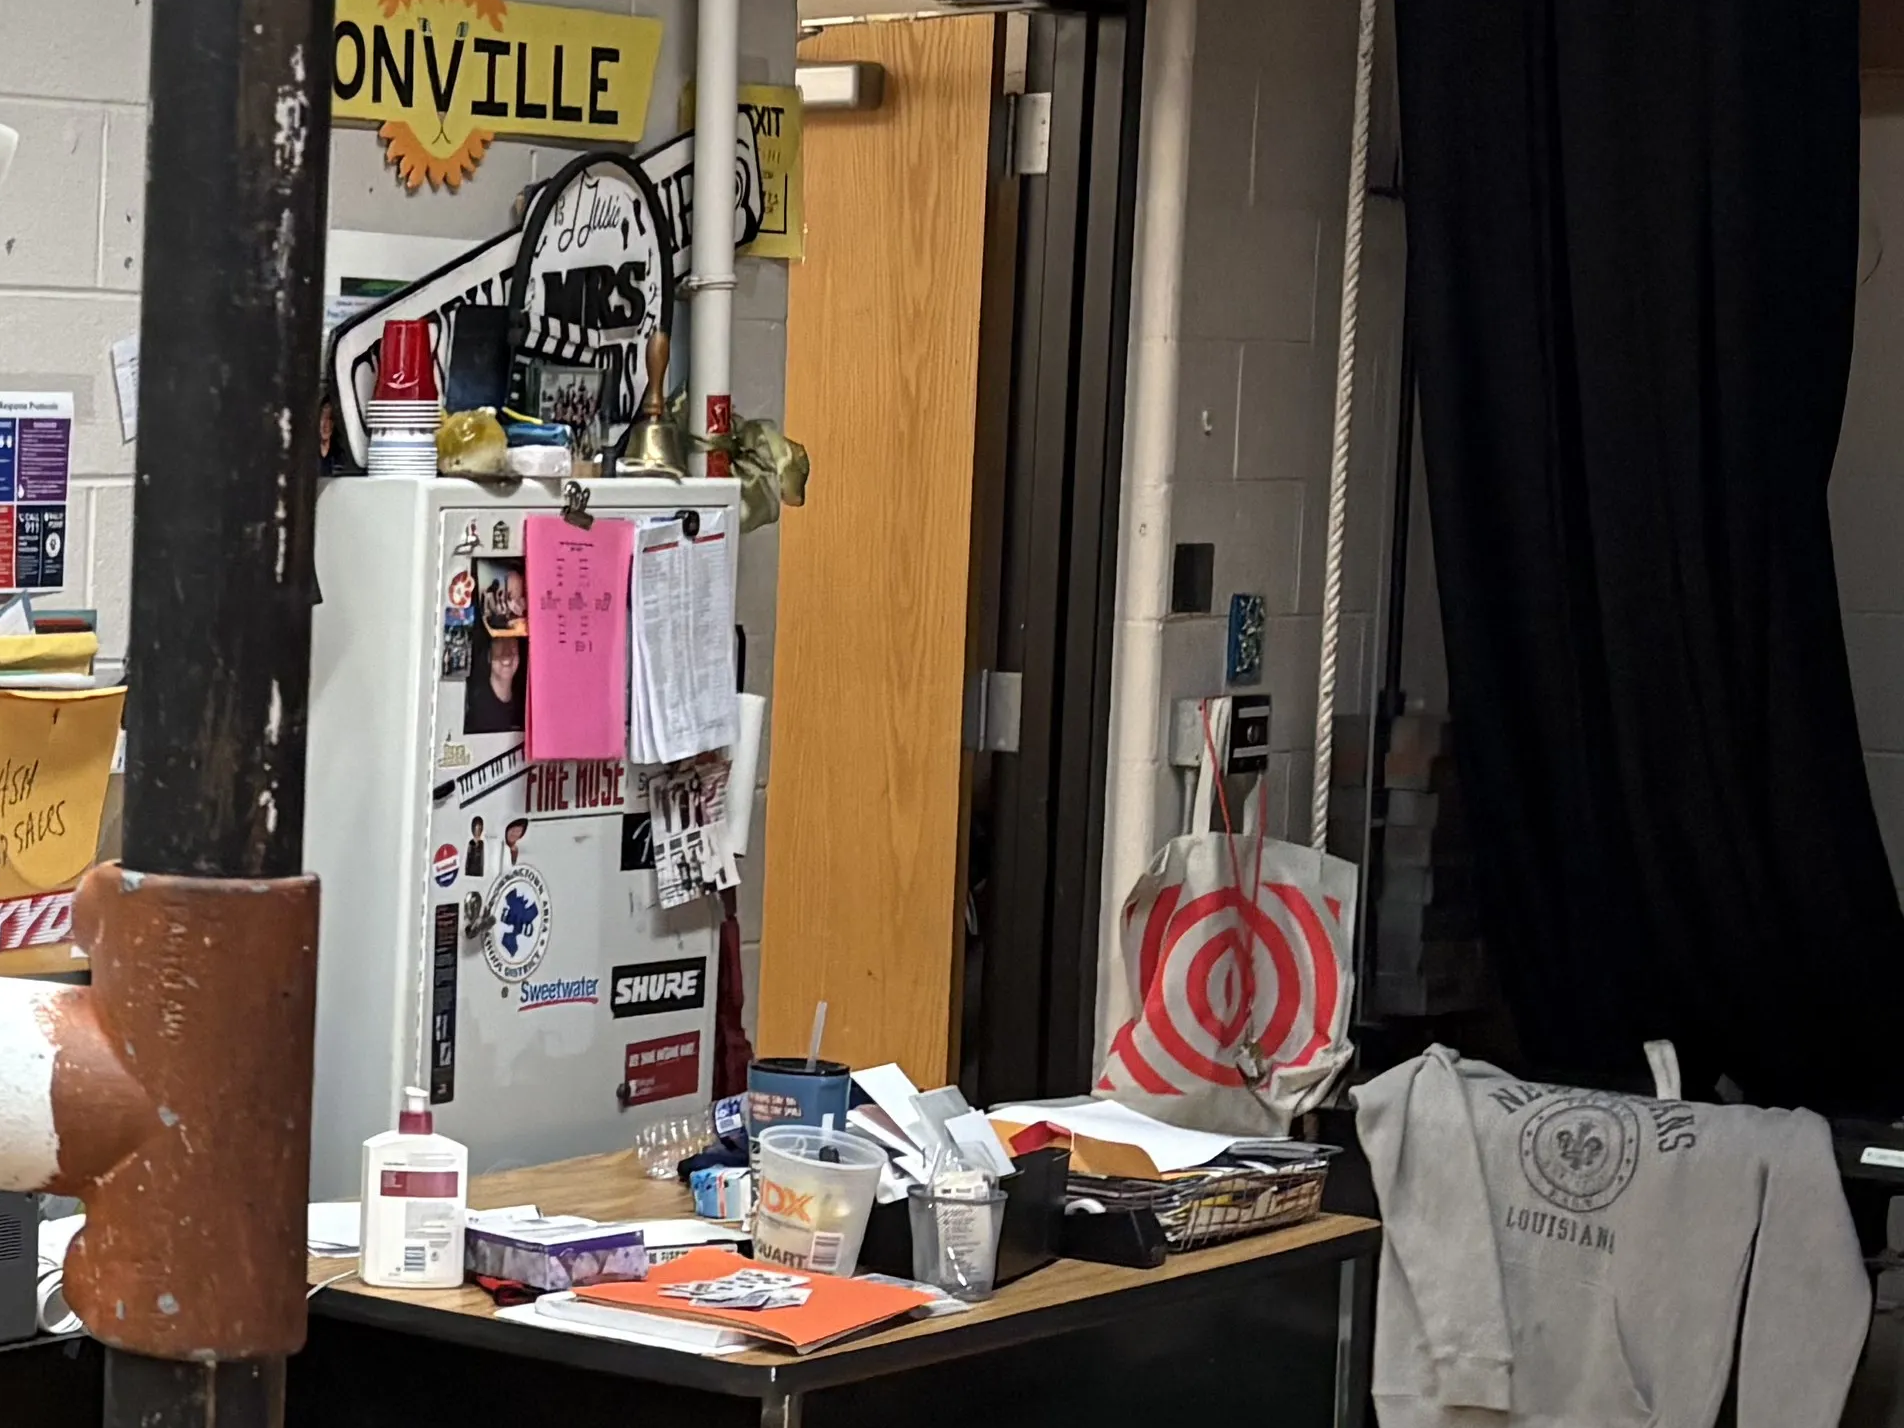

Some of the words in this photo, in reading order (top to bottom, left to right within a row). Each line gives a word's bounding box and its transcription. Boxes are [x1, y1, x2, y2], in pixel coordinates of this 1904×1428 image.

[542, 262, 647, 329] MRS
[520, 976, 599, 1003] Sweetwater
[614, 970, 701, 1005] SHURE
